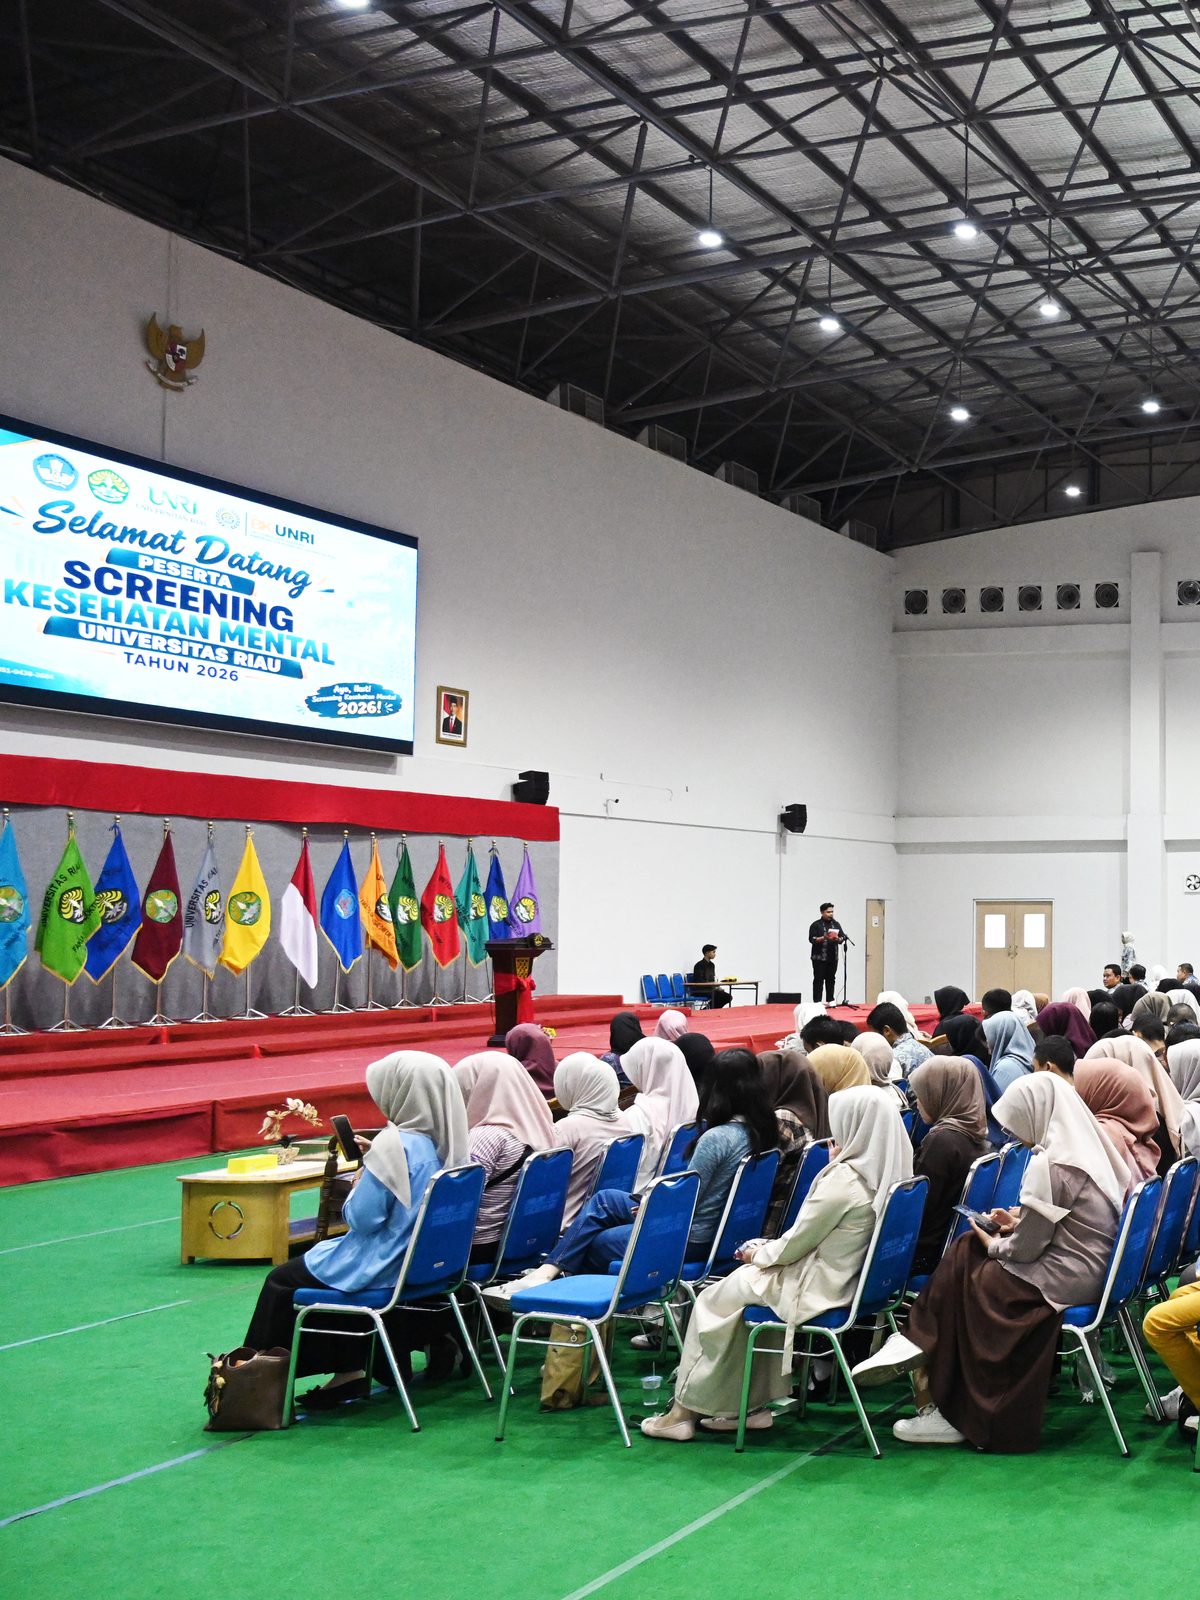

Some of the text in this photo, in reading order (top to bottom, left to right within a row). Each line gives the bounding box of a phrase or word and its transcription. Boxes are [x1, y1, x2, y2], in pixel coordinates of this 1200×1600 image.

[148, 485, 198, 515] UNRI
[32, 499, 312, 599] Selamat Datang
[275, 524, 315, 545] UNRI
[138, 554, 233, 589] PESERTA
[63, 560, 294, 633] SCREENING
[4, 578, 336, 666] KESEHATAN MENTAL
[78, 622, 282, 673] UNIVERSITAS RIAU
[123, 651, 239, 682] TAHUN 2026
[337, 700, 383, 715] 2026!
[184, 879, 209, 929] UNIVERSITAS
